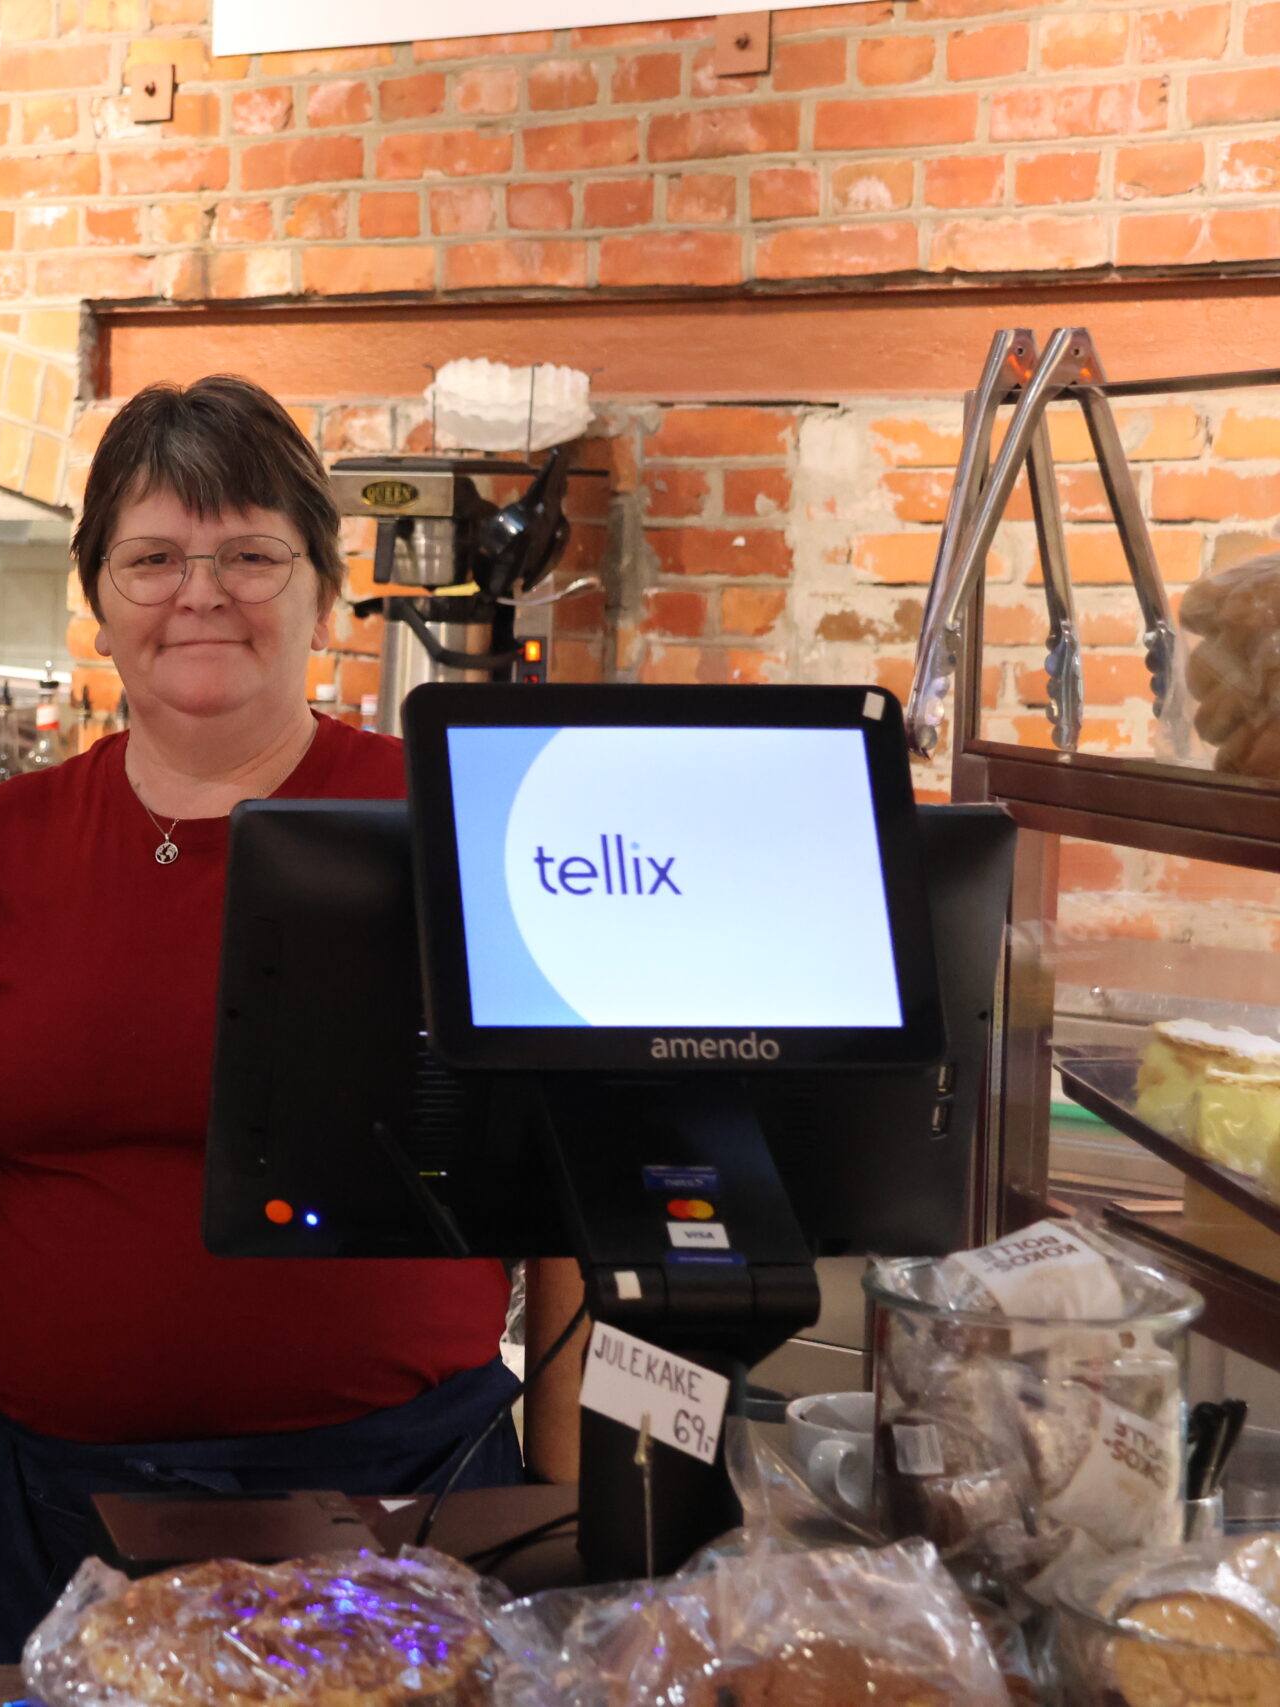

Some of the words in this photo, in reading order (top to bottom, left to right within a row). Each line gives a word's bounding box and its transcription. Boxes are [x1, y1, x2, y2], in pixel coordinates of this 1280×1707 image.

[366, 485, 412, 504] QUEEN
[534, 834, 681, 895] tellix
[650, 1031, 780, 1060] amendo
[683, 1231, 715, 1240] VISA
[594, 1334, 703, 1402] JULEKAKE
